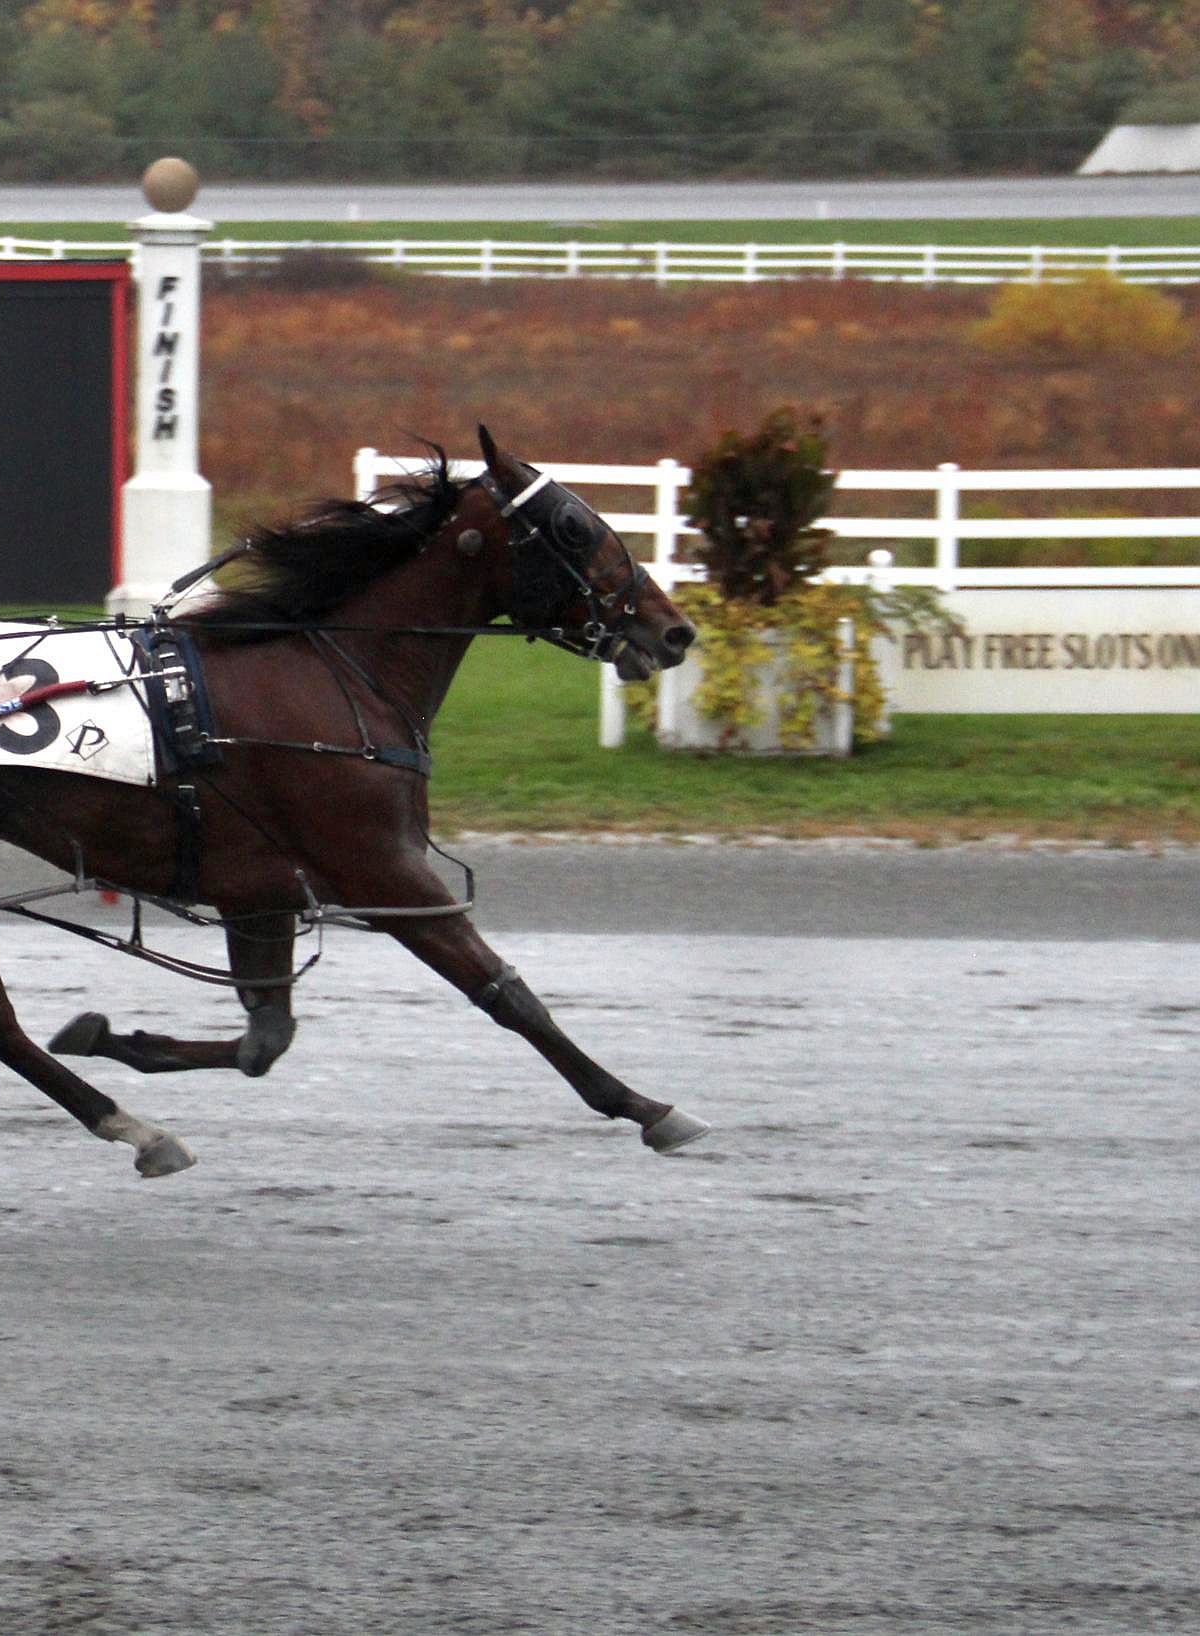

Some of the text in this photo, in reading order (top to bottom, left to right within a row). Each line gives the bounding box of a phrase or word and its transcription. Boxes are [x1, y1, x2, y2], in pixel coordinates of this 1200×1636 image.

[152, 276, 179, 440] FINISH
[903, 633, 974, 670] PLAY
[983, 633, 1055, 670] FREE
[1062, 633, 1152, 670] SLOTS
